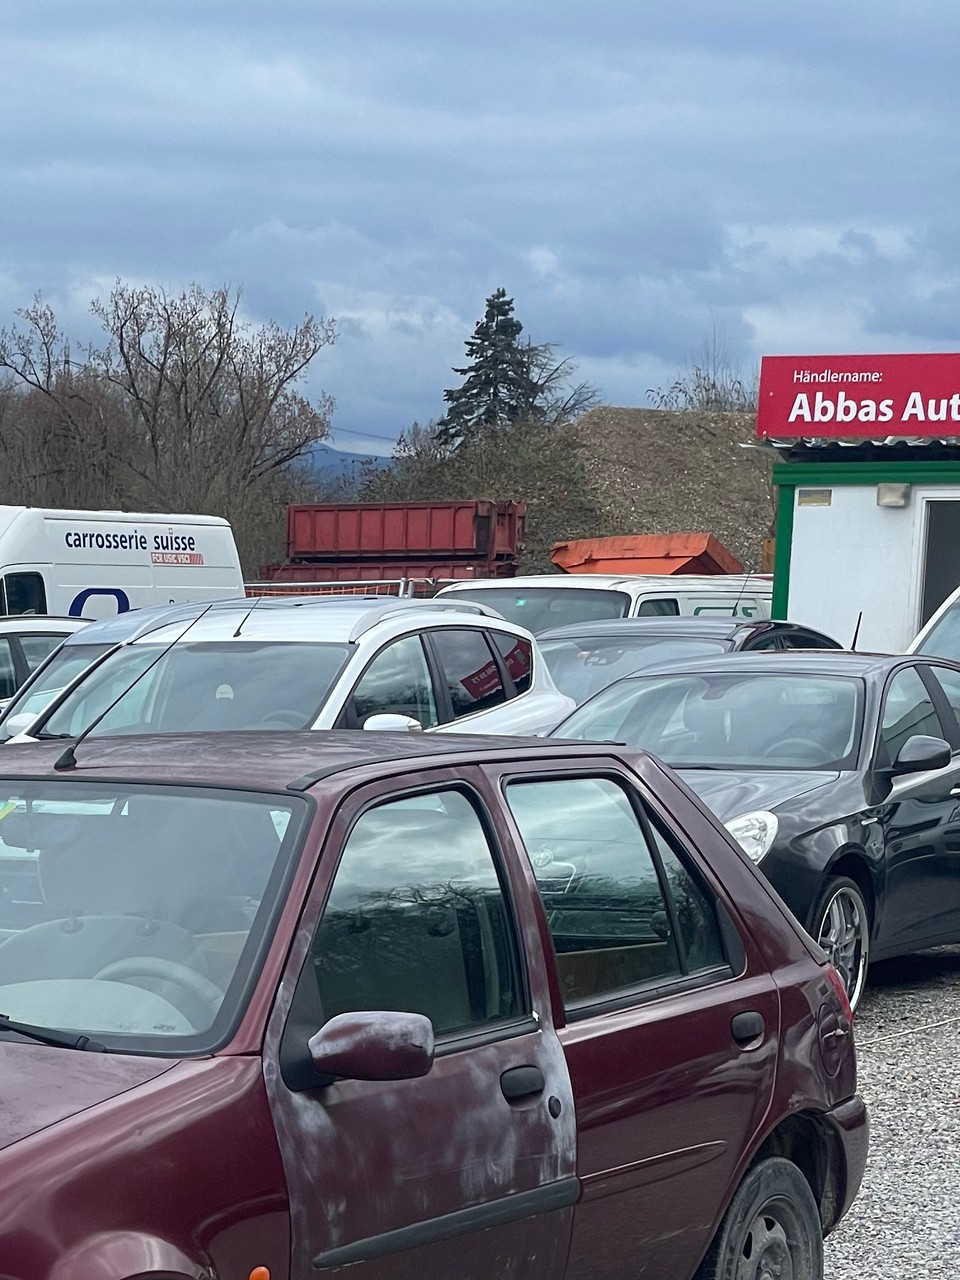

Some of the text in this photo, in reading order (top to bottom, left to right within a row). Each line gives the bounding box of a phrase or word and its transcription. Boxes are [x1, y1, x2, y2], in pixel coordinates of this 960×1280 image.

[793, 370, 883, 383] Händlername:
[788, 391, 960, 422] Abbas Aut
[65, 528, 195, 551] carrosserie suisse
